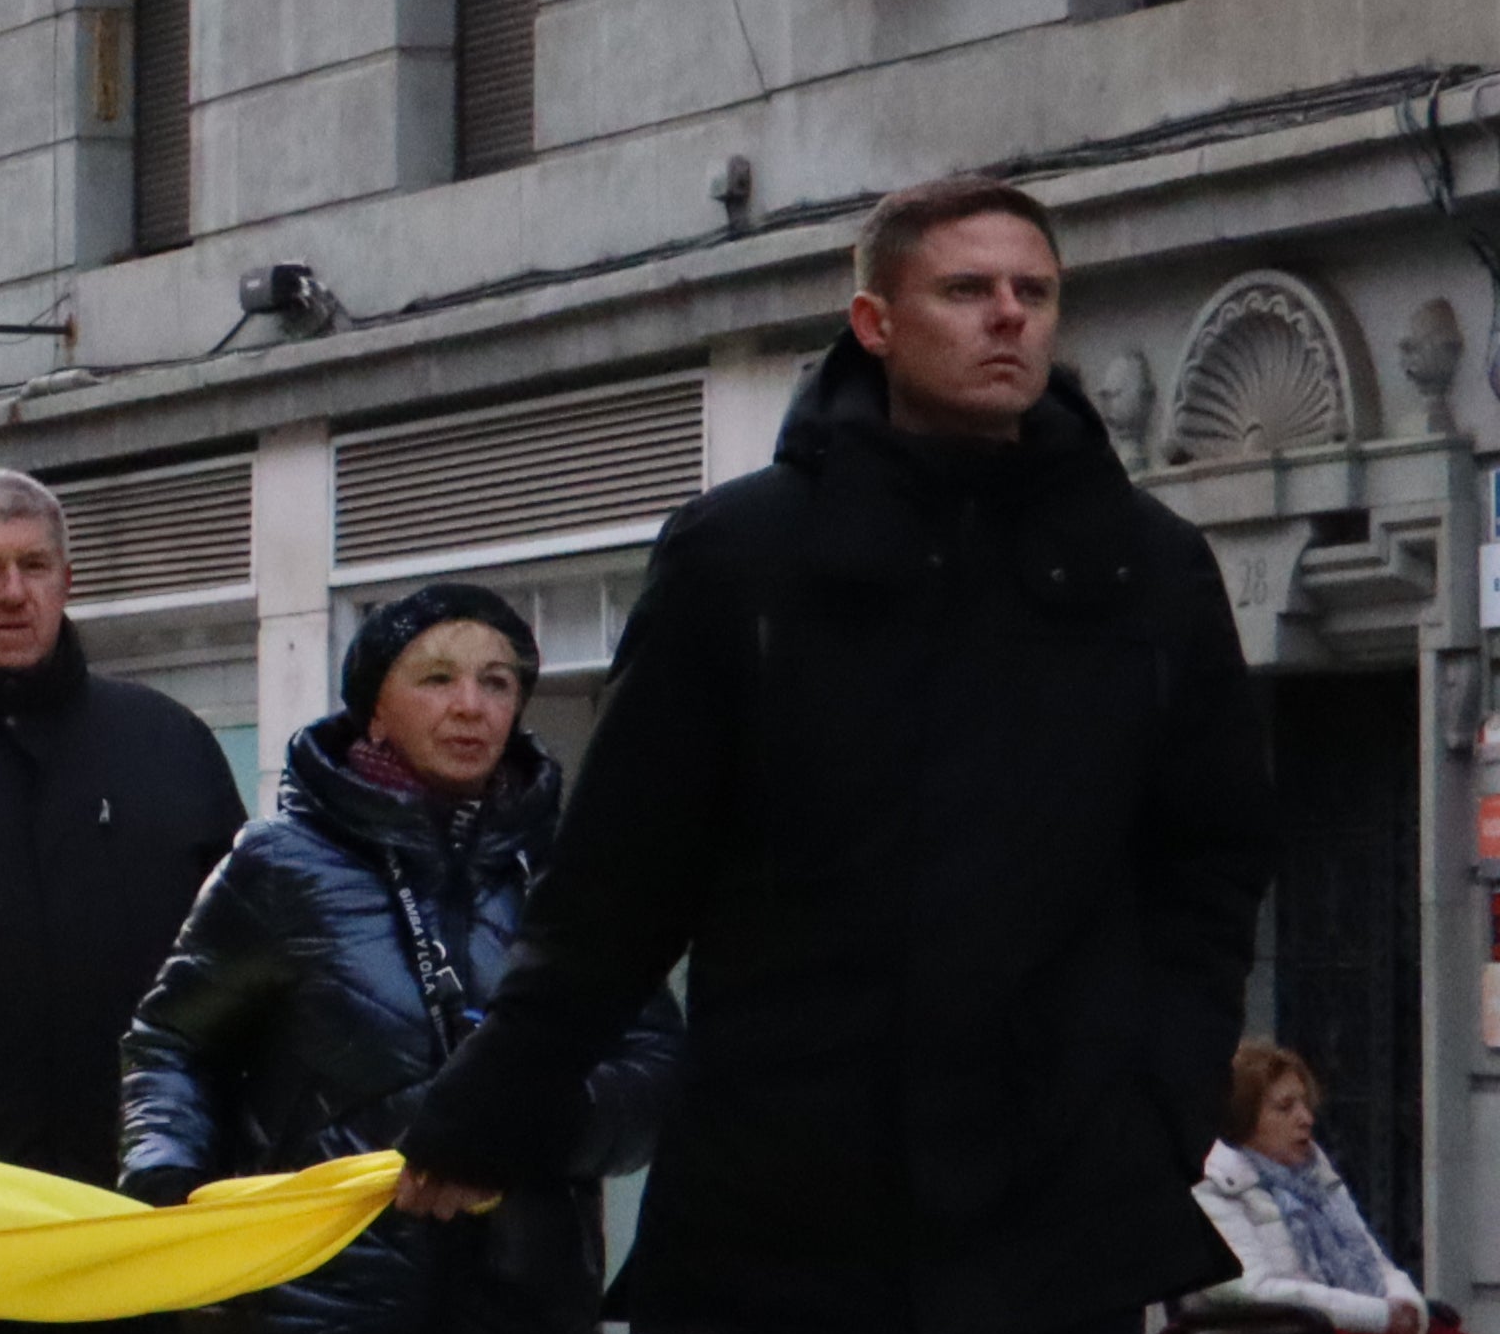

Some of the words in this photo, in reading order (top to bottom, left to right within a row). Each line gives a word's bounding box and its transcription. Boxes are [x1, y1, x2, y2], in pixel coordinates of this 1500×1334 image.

[399, 887, 425, 936] BIMBA
[416, 938, 429, 949] Y
[417, 951, 437, 996] LOLA
